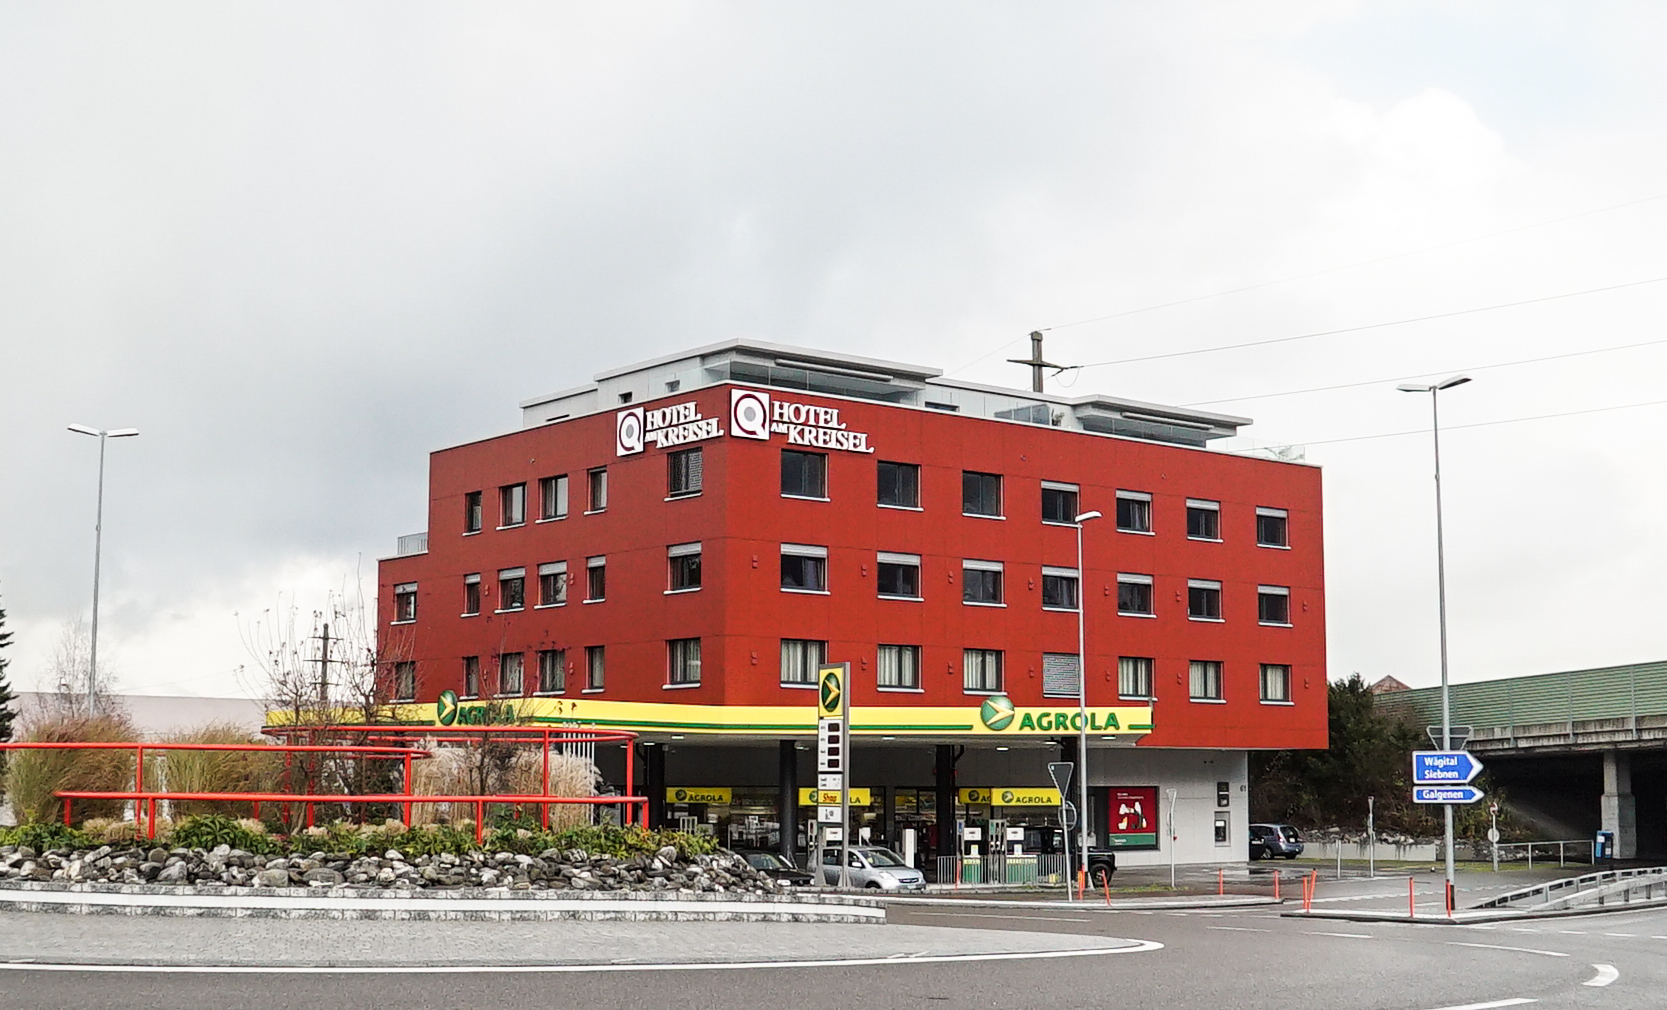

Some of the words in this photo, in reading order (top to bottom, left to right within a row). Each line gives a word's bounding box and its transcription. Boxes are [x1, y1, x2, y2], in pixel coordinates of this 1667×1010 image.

[645, 401, 702, 430] HOTEL
[772, 400, 847, 429] HOTEL
[655, 417, 725, 449] KREISEL
[770, 422, 788, 433] AM
[787, 424, 875, 453] KREISEL
[1019, 712, 1121, 731] AGROLA
[1424, 756, 1458, 768] Wägital
[1424, 769, 1459, 779] Siebnen
[687, 794, 724, 802] AGROLA
[1015, 796, 1053, 804] AGROLA
[1422, 789, 1464, 800] Galgenen
